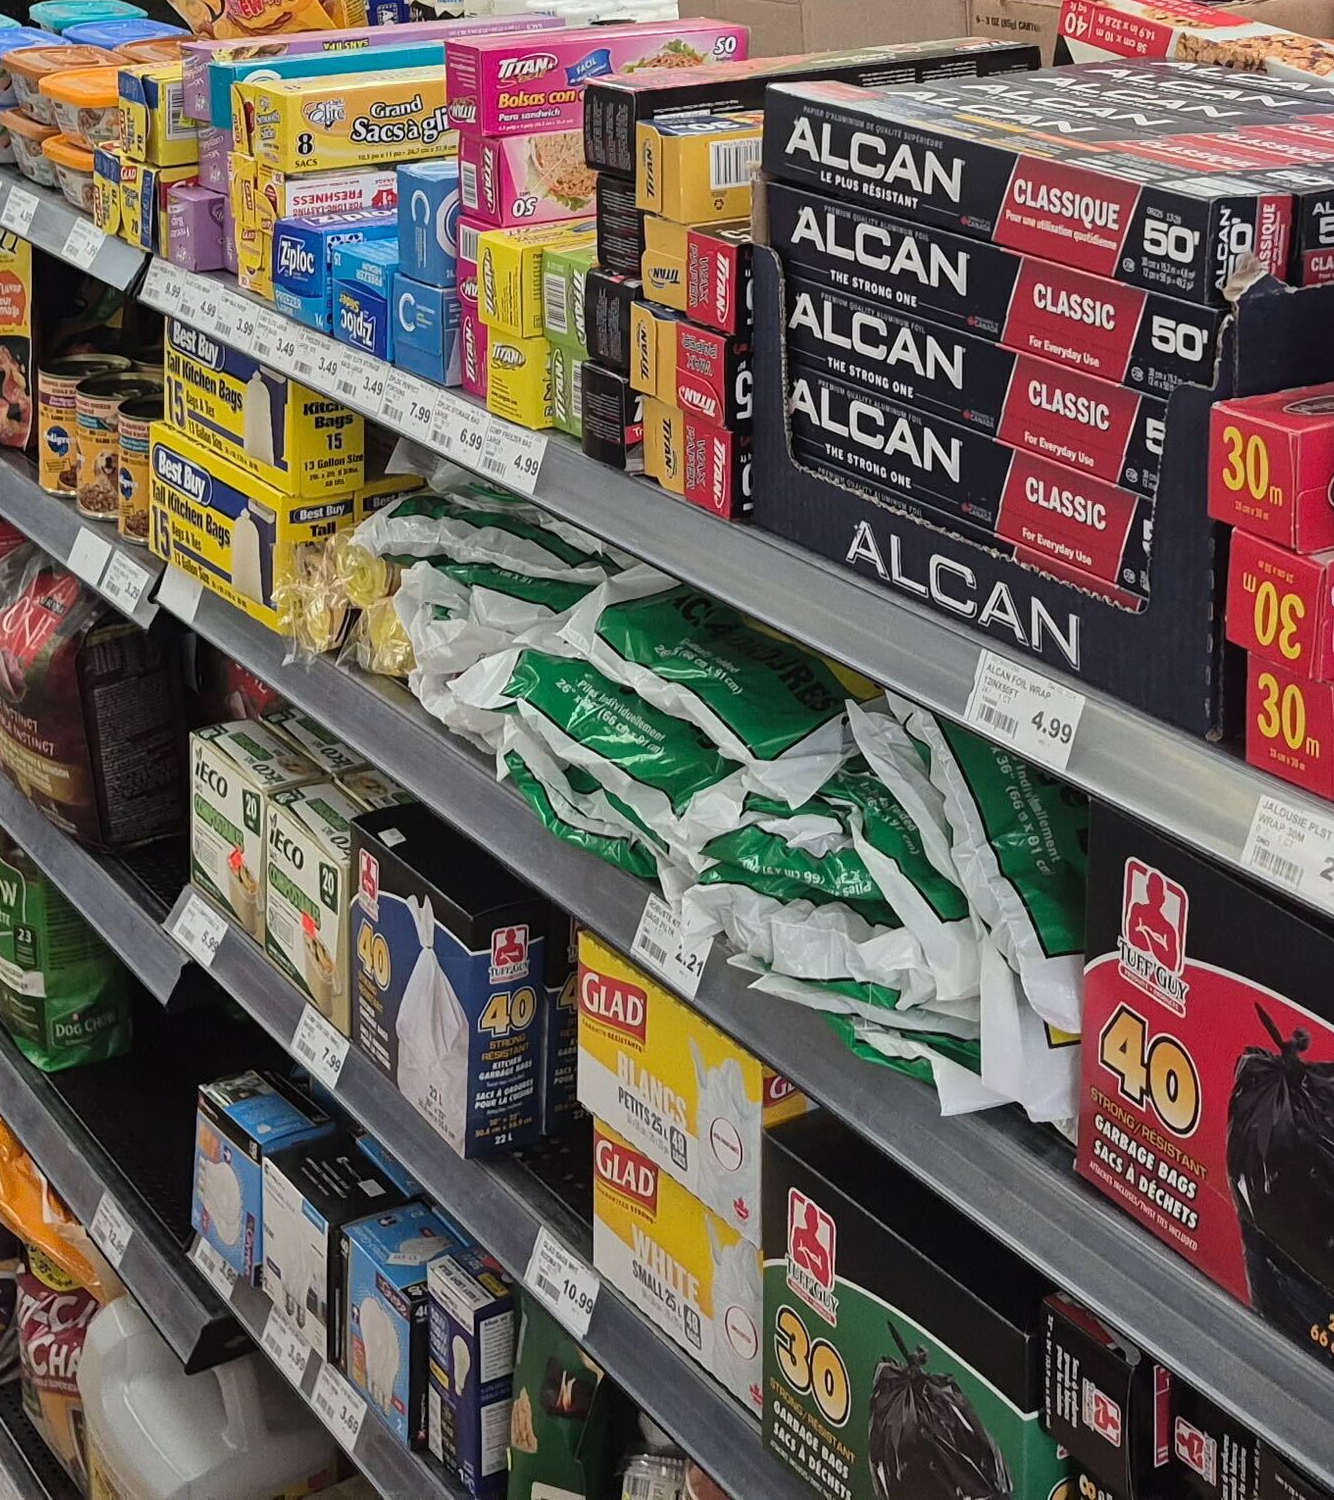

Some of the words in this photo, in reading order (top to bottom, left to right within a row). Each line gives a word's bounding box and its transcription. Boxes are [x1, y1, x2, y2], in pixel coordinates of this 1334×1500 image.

[712, 35, 738, 56] 50
[496, 55, 552, 79] TITAN
[370, 94, 423, 118] Grand
[497, 89, 546, 109] Bolsas
[548, 89, 577, 104] con
[498, 111, 520, 123] Para
[521, 107, 562, 120] sandwich
[295, 132, 314, 156] 8
[351, 116, 406, 143] Sacs
[407, 117, 420, 140] à
[294, 158, 318, 169] SACS
[645, 147, 655, 200] TITAN
[785, 115, 966, 204] ALCAN
[292, 189, 364, 207] FRESHNESS
[819, 170, 833, 184] LE
[834, 174, 860, 194] PLUS
[861, 180, 920, 210] RÉSISTANT
[1012, 177, 1121, 233] CLASSIQUE
[280, 239, 316, 277] Ziploc
[790, 205, 971, 297] ALCAN
[829, 269, 848, 285] THE
[850, 274, 893, 301] STRONG
[895, 290, 918, 308] ONE
[1032, 282, 1116, 332] CLASSIC
[171, 321, 197, 352] Best
[197, 335, 220, 368] Buy
[235, 318, 255, 337] 3.99
[276, 338, 296, 358] 3.49
[788, 292, 965, 390] ALCAN
[1028, 334, 1042, 350] For
[1043, 338, 1083, 367] Everyday
[1083, 351, 1100, 368] Use
[181, 359, 218, 399] Kitchen
[218, 382, 244, 414] Bags
[827, 355, 846, 373] THE
[848, 364, 890, 390] STRONG
[892, 380, 915, 399] ONE
[166, 378, 187, 431] 15
[409, 402, 432, 424] 7.99
[1027, 379, 1111, 431] CLASSIC
[459, 428, 484, 452] 6.99
[787, 377, 964, 484] ALCAN
[514, 454, 540, 477] 4.99
[1024, 475, 1108, 531] CLASSIC
[845, 519, 1083, 672] ALCAN
[986, 662, 1011, 684] ALCAN
[1010, 675, 1028, 690] FOIL
[1028, 684, 1052, 701] WRAP
[1030, 710, 1073, 745] 4.99
[1261, 799, 1308, 830] JALOUSIE
[1308, 822, 1334, 845] PLST
[1118, 937, 1155, 979] TUFF
[1155, 965, 1191, 1004] GUY
[476, 986, 537, 1038] 40
[581, 971, 644, 1027] GLAD
[321, 1046, 342, 1074] 7.99
[1098, 1001, 1203, 1139] 40
[617, 1086, 651, 1126] PETITS
[1093, 1113, 1157, 1176] GARBAGE
[1158, 1159, 1198, 1201] BAGS
[1092, 1139, 1124, 1177] SACS
[1124, 1159, 1137, 1186] À
[1138, 1173, 1199, 1232] DÉCHETS
[629, 1225, 702, 1305] WHITE
[561, 1277, 596, 1317] 10.99
[774, 1305, 851, 1428] 30
